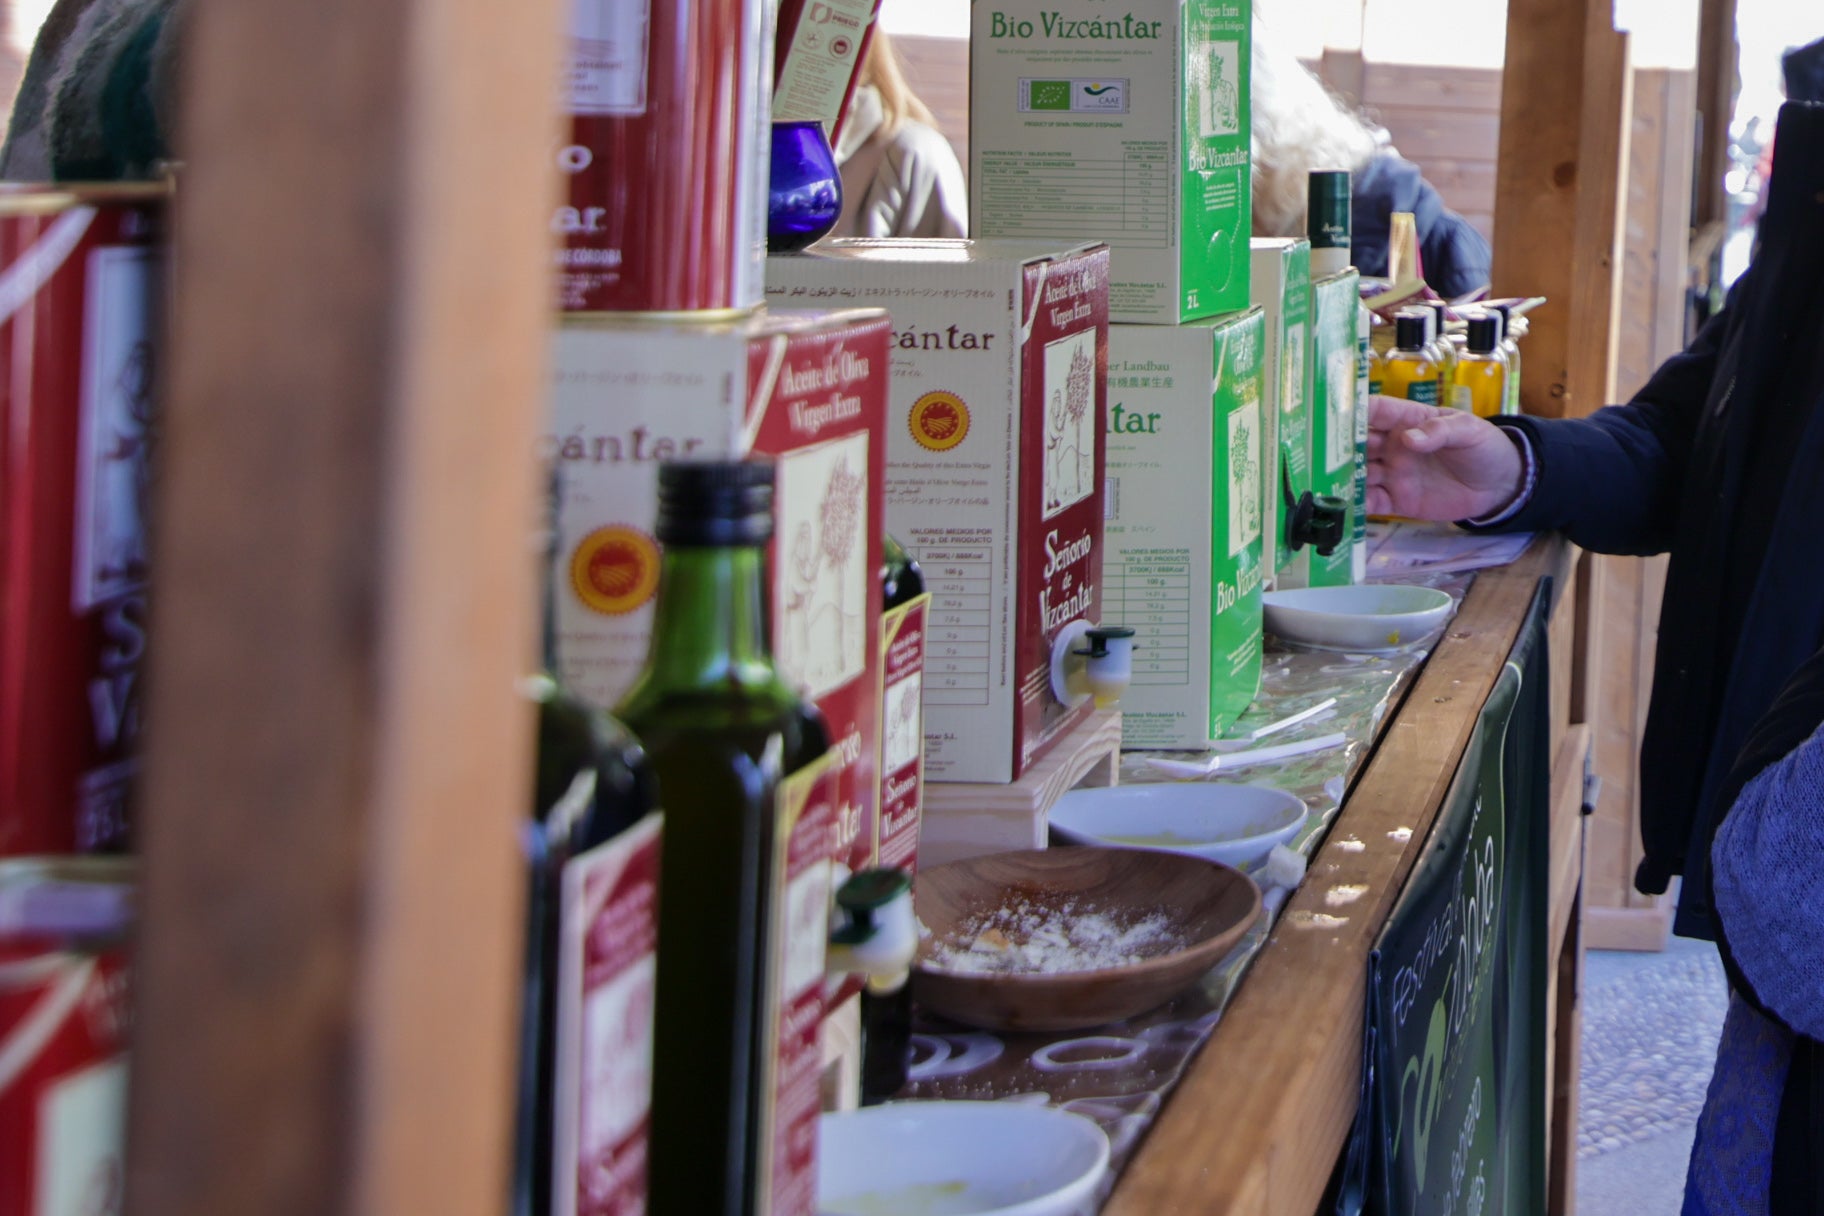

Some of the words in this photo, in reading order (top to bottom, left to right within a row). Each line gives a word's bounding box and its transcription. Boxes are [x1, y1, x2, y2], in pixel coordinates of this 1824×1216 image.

[990, 11, 1034, 38] Bio
[1040, 11, 1162, 40] Vizcántar
[840, 350, 870, 384] Oliva
[1123, 360, 1170, 371] Landbau
[1043, 527, 1092, 581] Señorío
[1062, 571, 1073, 591] de
[1215, 580, 1236, 616] Bio
[1039, 581, 1093, 636] Vizcántar
